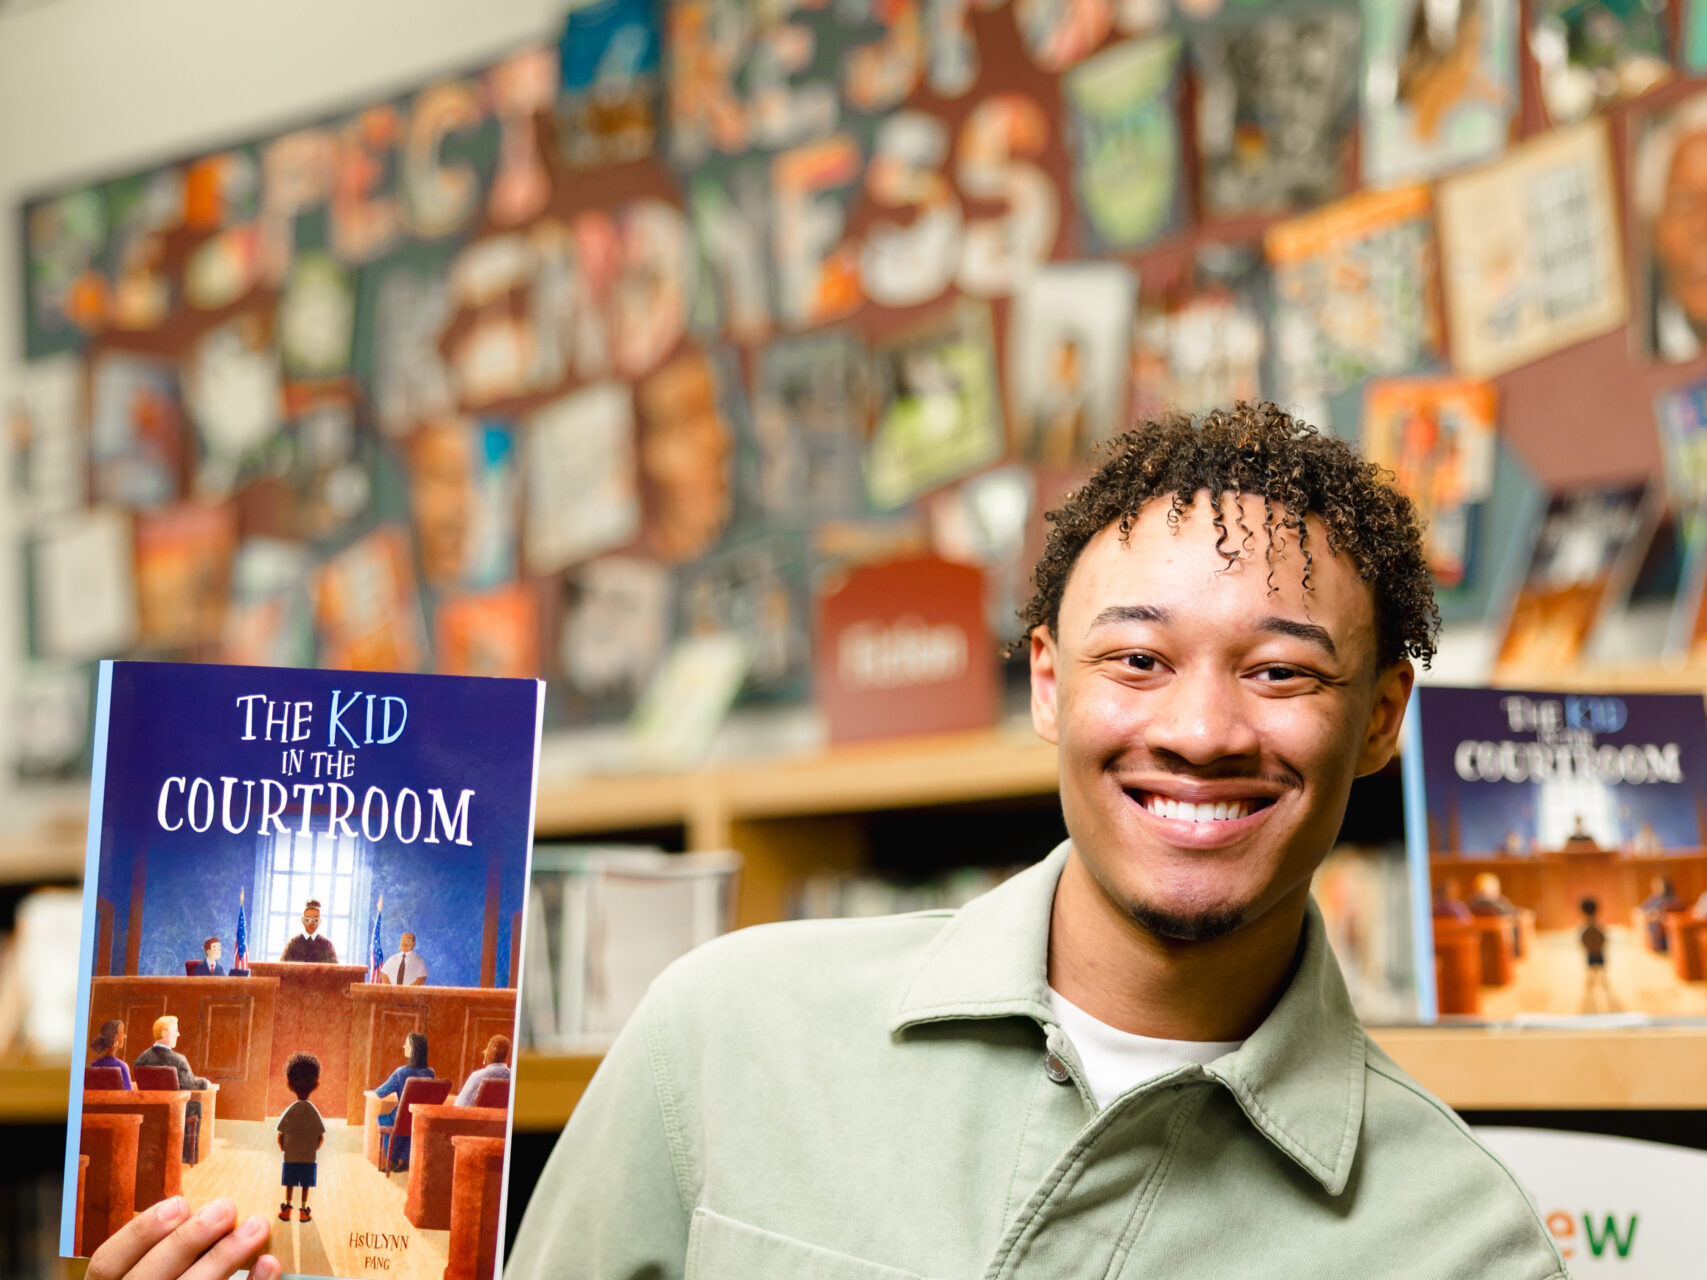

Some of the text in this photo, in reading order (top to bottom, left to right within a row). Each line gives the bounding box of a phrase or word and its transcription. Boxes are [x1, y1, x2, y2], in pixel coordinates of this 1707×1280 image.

[237, 690, 408, 748] THE KID
[281, 749, 356, 780] IN THE
[1454, 740, 1684, 785] COURTROOM
[157, 776, 476, 846] COURTROOM
[1546, 1207, 1638, 1259] ew
[364, 1255, 391, 1271] PANG
